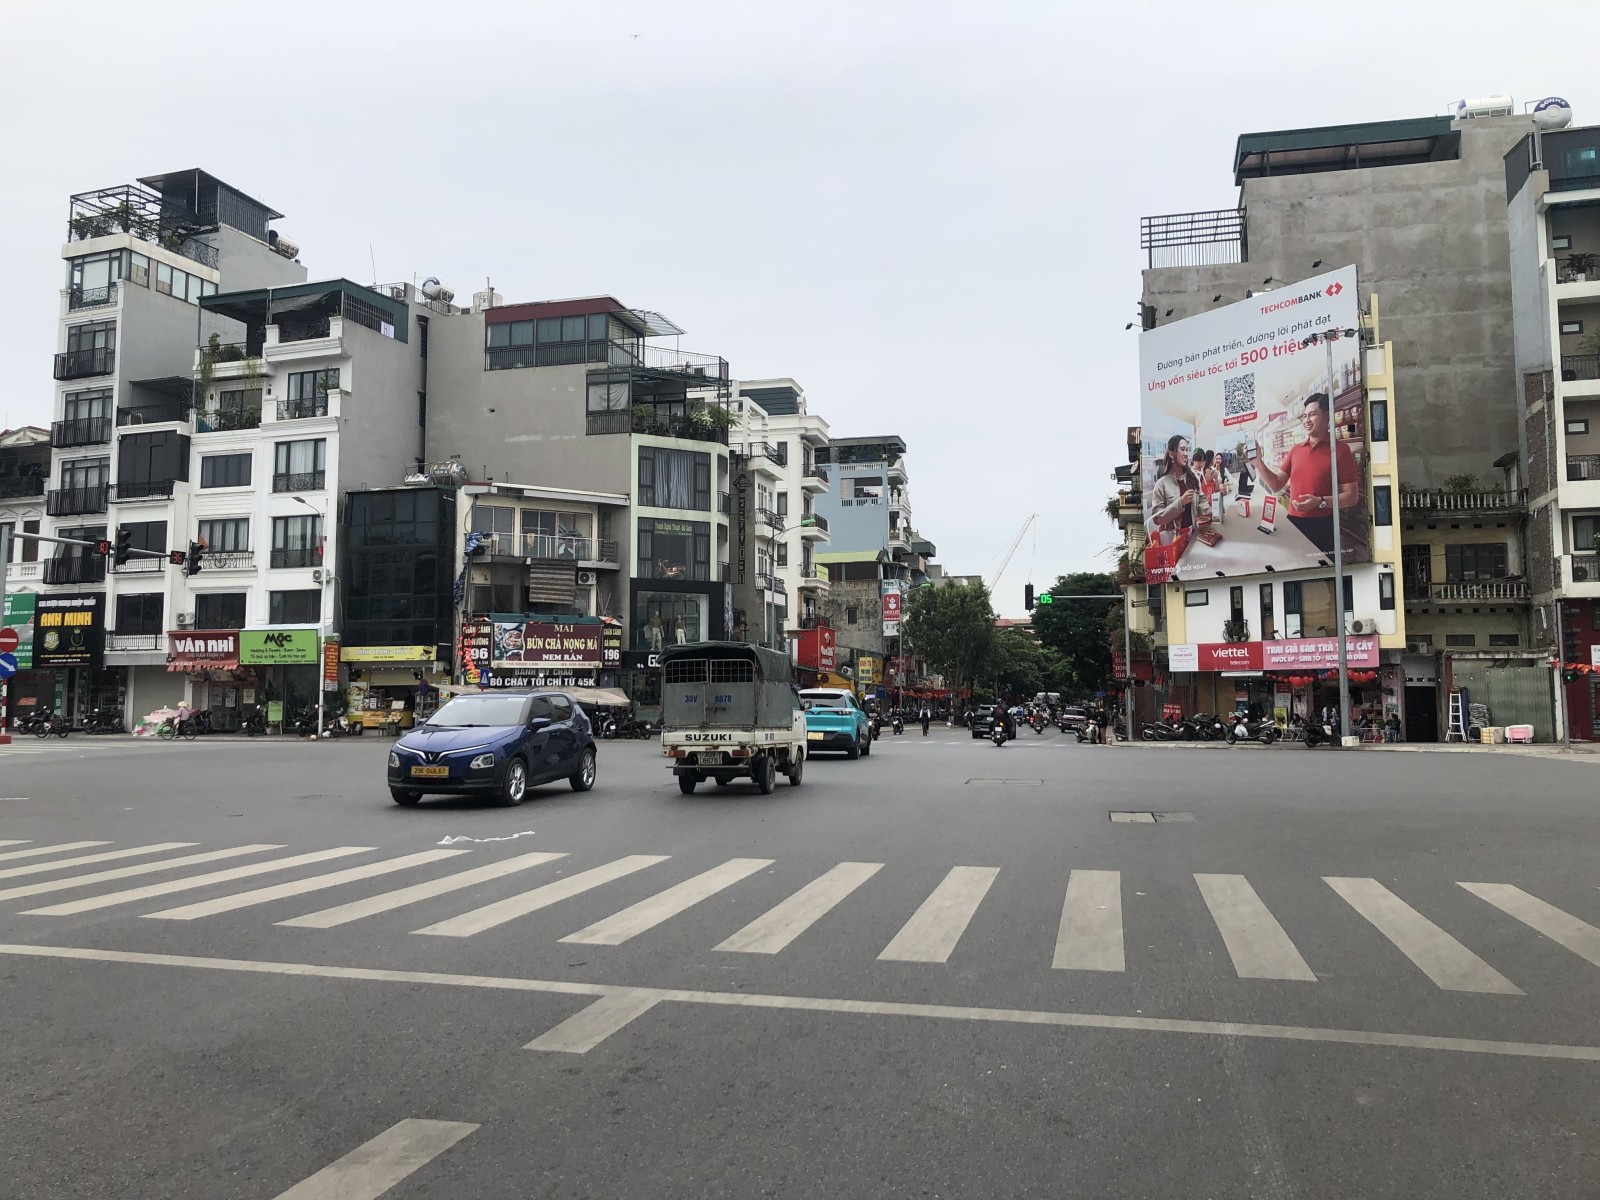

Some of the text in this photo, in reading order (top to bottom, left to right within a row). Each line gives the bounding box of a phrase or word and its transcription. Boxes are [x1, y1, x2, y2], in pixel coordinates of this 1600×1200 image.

[1260, 290, 1322, 314] TECHCOMBANK
[1185, 352, 1200, 363] bán
[1202, 345, 1221, 360] phát
[1246, 329, 1275, 346] đường
[1277, 323, 1289, 336] lời
[1291, 317, 1313, 335] phát
[1314, 313, 1332, 326] đạt
[1148, 339, 1307, 392] Ứng vốn siêu tốc tới 500 triệu
[1041, 594, 1052, 604] 05
[40, 612, 92, 626] ANH MINH
[554, 624, 574, 632] MAI
[527, 634, 598, 652] BÚN CHẢ NỌNG MÁ
[1356, 640, 1373, 650] CÂY
[470, 648, 488, 659] 96
[604, 649, 619, 660] 196
[1212, 648, 1249, 658] viettel
[504, 676, 528, 686] CHÁY
[547, 676, 562, 686] CHỈ
[564, 676, 576, 686] TỪ
[578, 678, 595, 686] 45K
[685, 695, 698, 703] 30V
